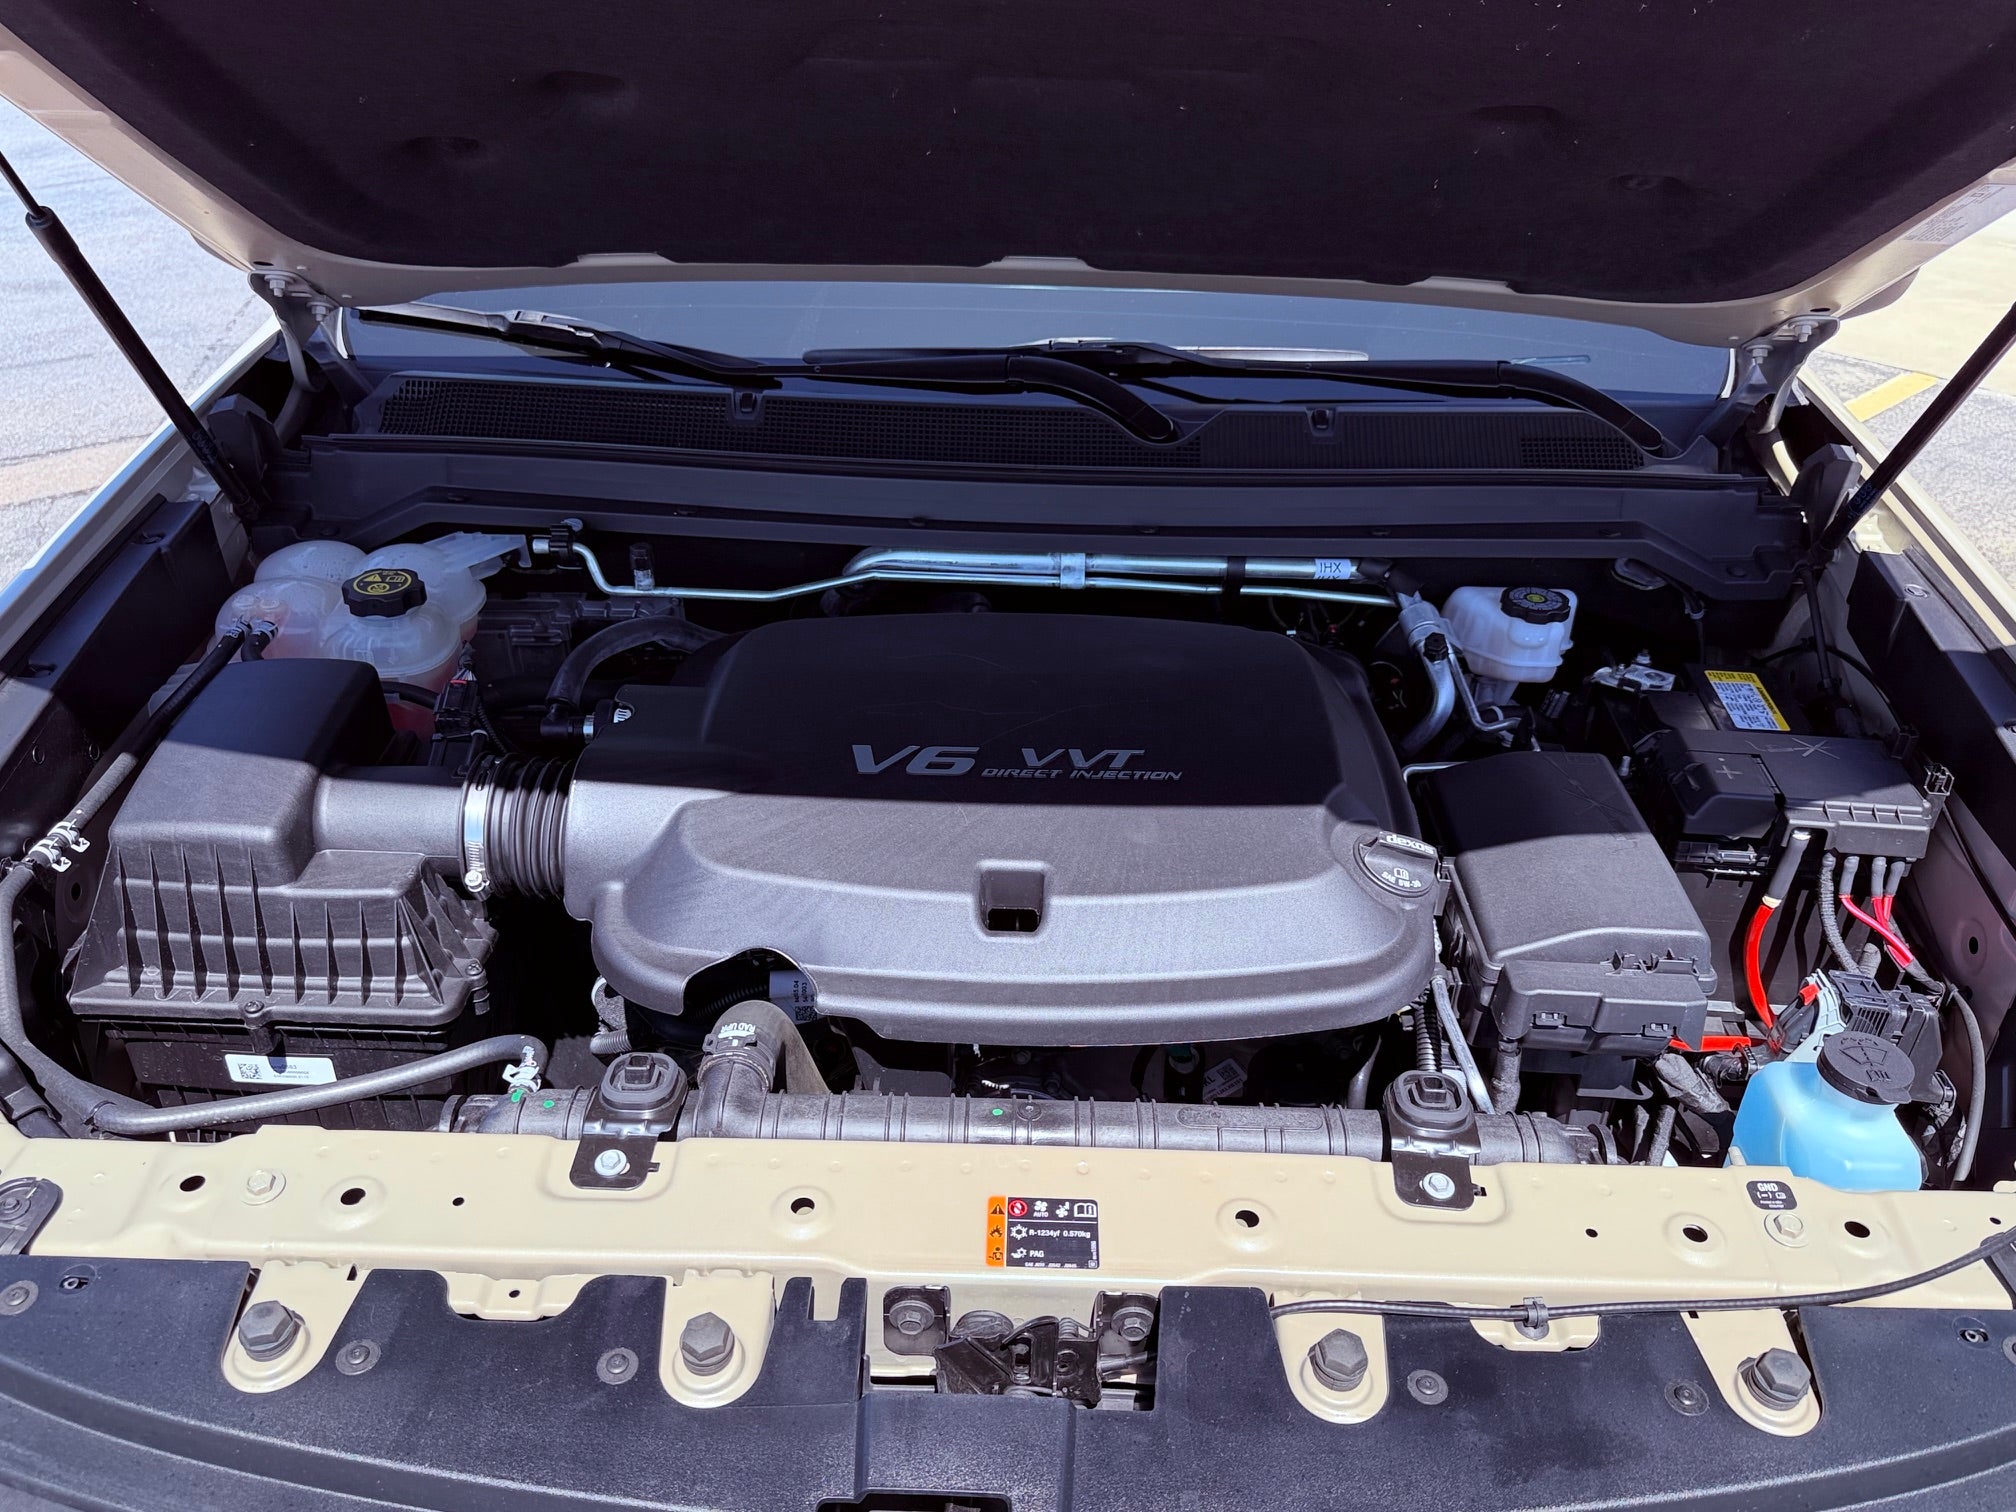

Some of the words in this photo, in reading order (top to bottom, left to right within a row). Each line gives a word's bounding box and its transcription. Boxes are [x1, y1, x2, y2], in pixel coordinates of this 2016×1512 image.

[851, 744, 981, 777] V6
[1021, 748, 1146, 769] VVT
[981, 768, 1063, 779] DIRECT
[1069, 769, 1183, 782] INJECTION
[1386, 834, 1434, 855] dexos
[1757, 1182, 1779, 1192] GND
[1029, 1229, 1060, 1238] R-1234yf
[1029, 1250, 1045, 1258] PAG
